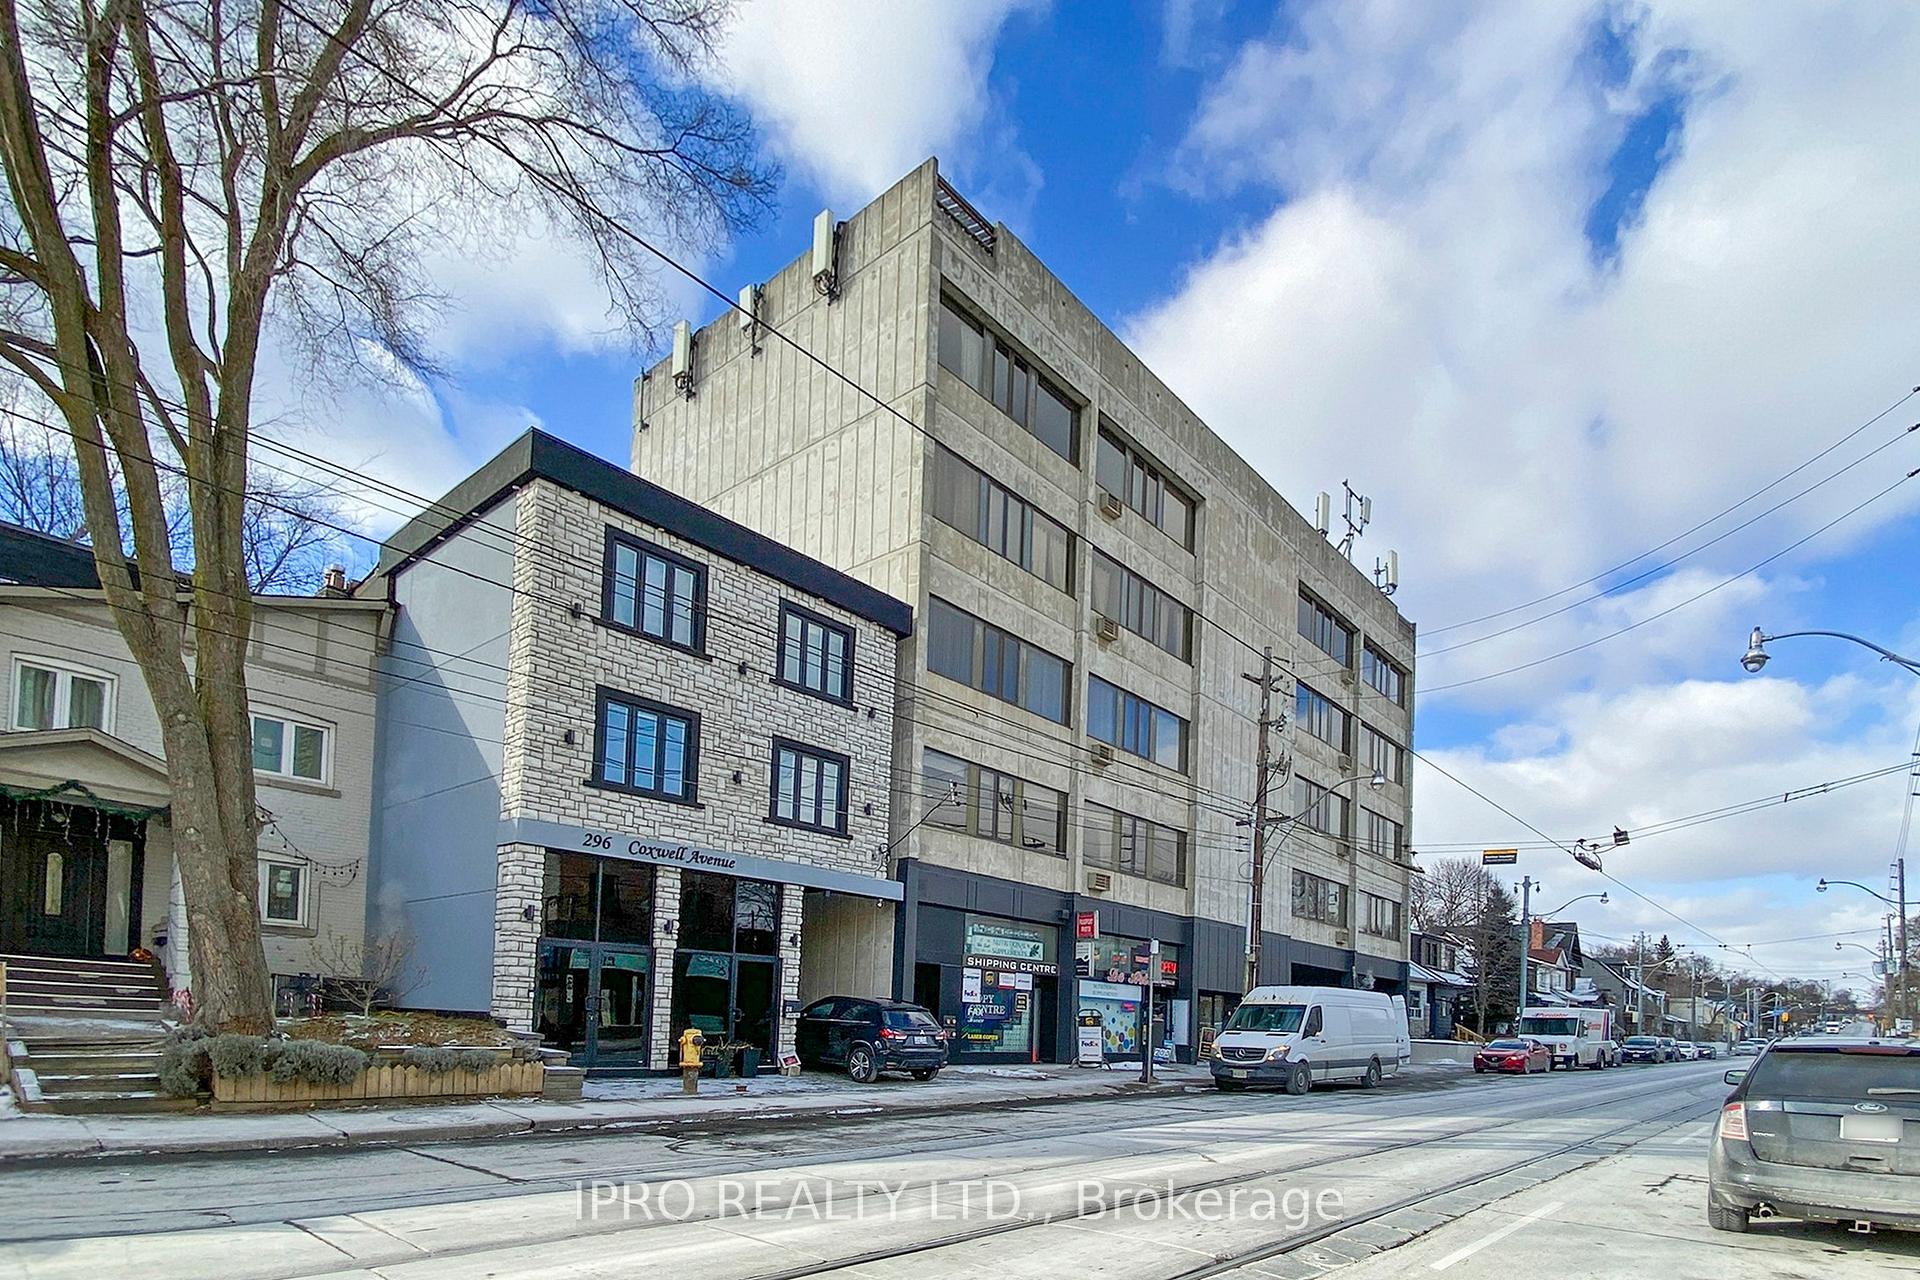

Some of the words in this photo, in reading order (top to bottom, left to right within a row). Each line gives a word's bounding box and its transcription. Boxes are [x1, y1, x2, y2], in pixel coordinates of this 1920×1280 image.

[582, 833, 613, 850] 296
[628, 840, 688, 860] Coxwell
[686, 850, 736, 869] Avenue
[967, 957, 1017, 970] SHIPPING
[1020, 962, 1057, 974] CENTRE
